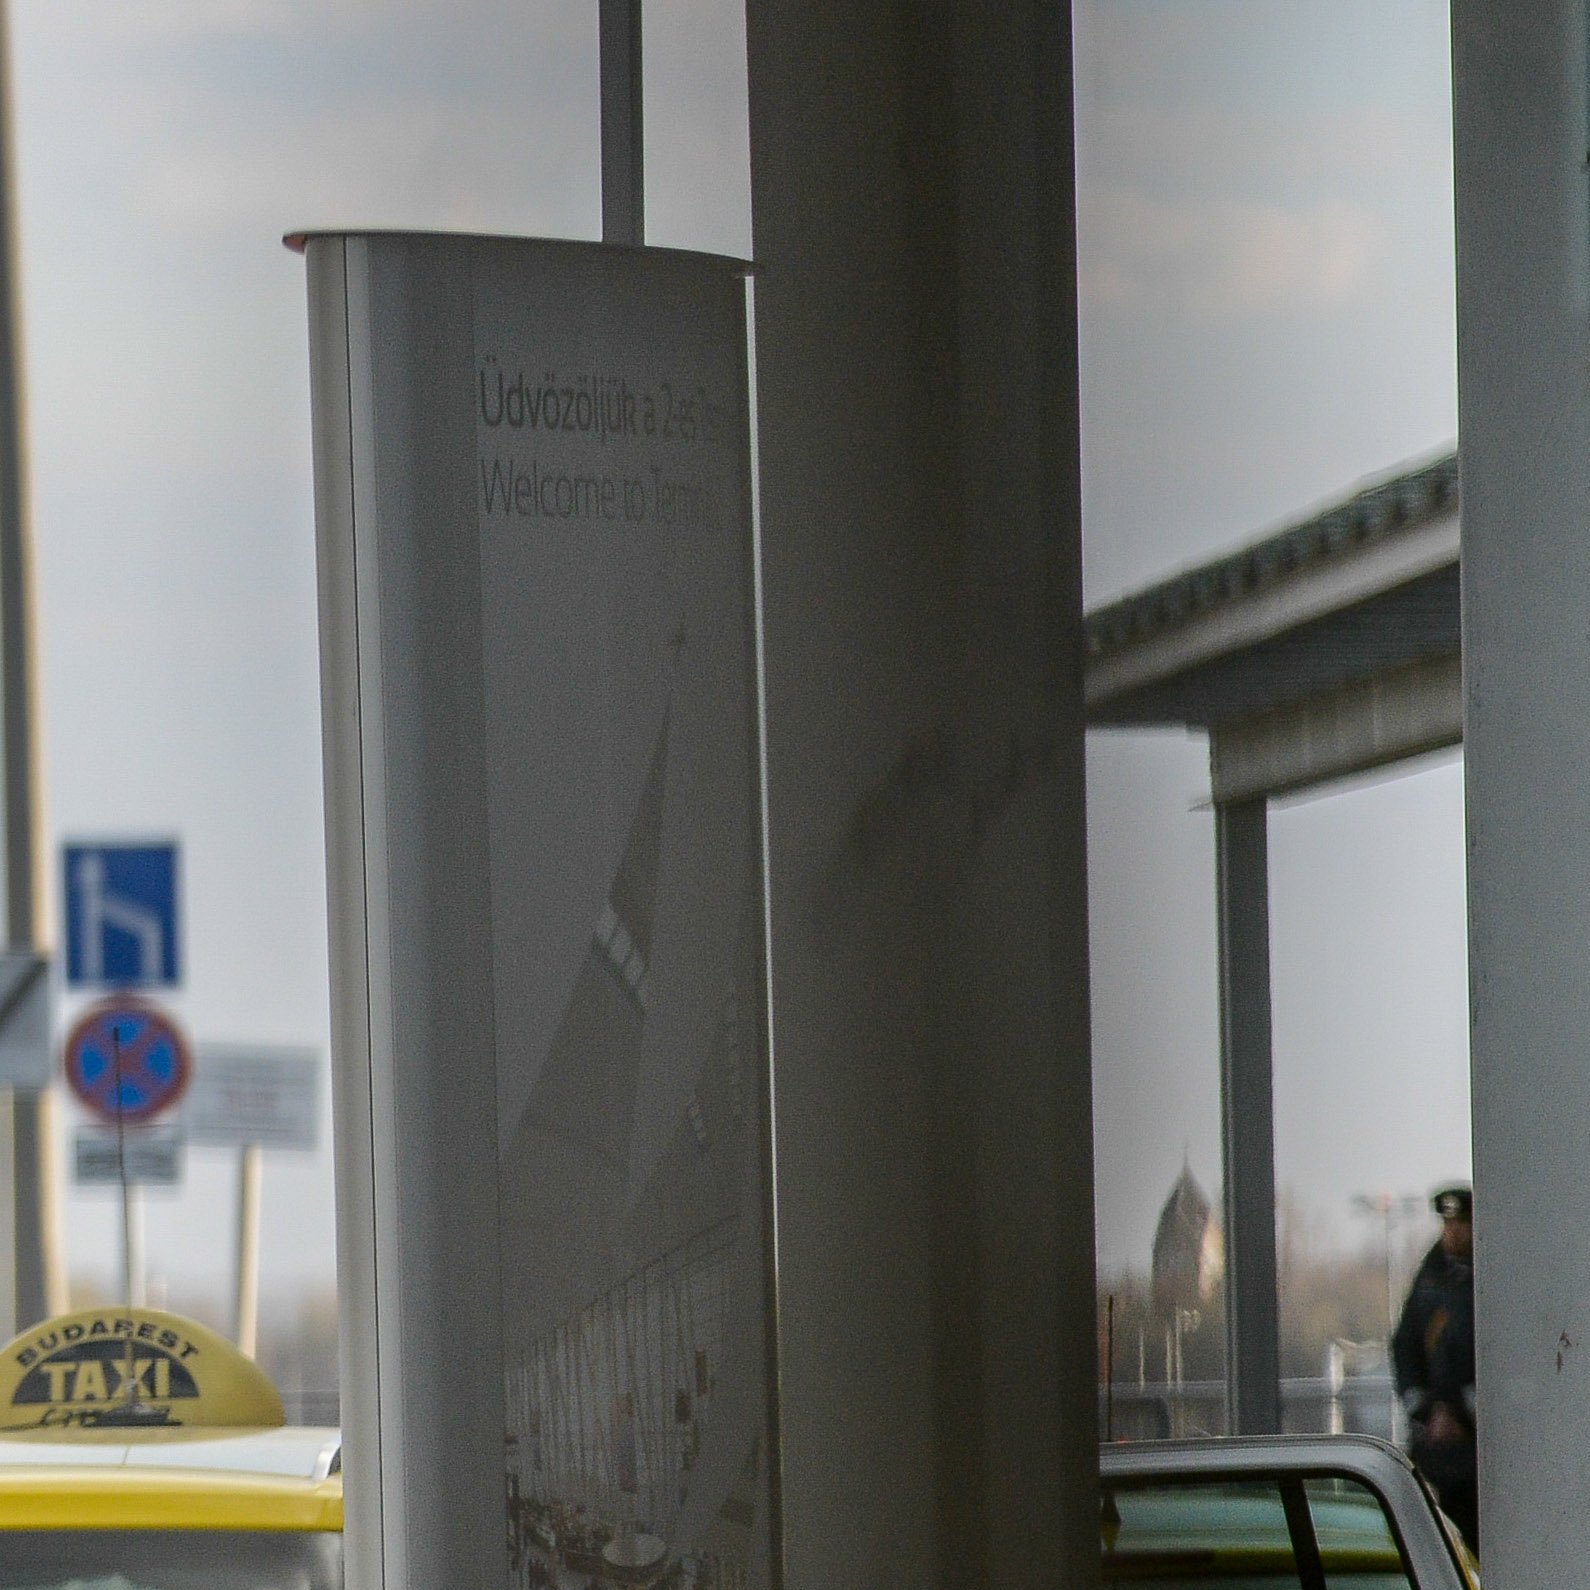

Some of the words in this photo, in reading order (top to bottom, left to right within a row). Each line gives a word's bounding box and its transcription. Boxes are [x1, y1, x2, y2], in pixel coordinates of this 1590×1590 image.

[479, 354, 637, 446] Üdvözöljük
[643, 393, 657, 436] a
[480, 458, 616, 522] Welcome
[622, 477, 647, 523] to
[15, 1318, 199, 1368] BUDAPEST
[40, 1357, 170, 1404] TAXI
